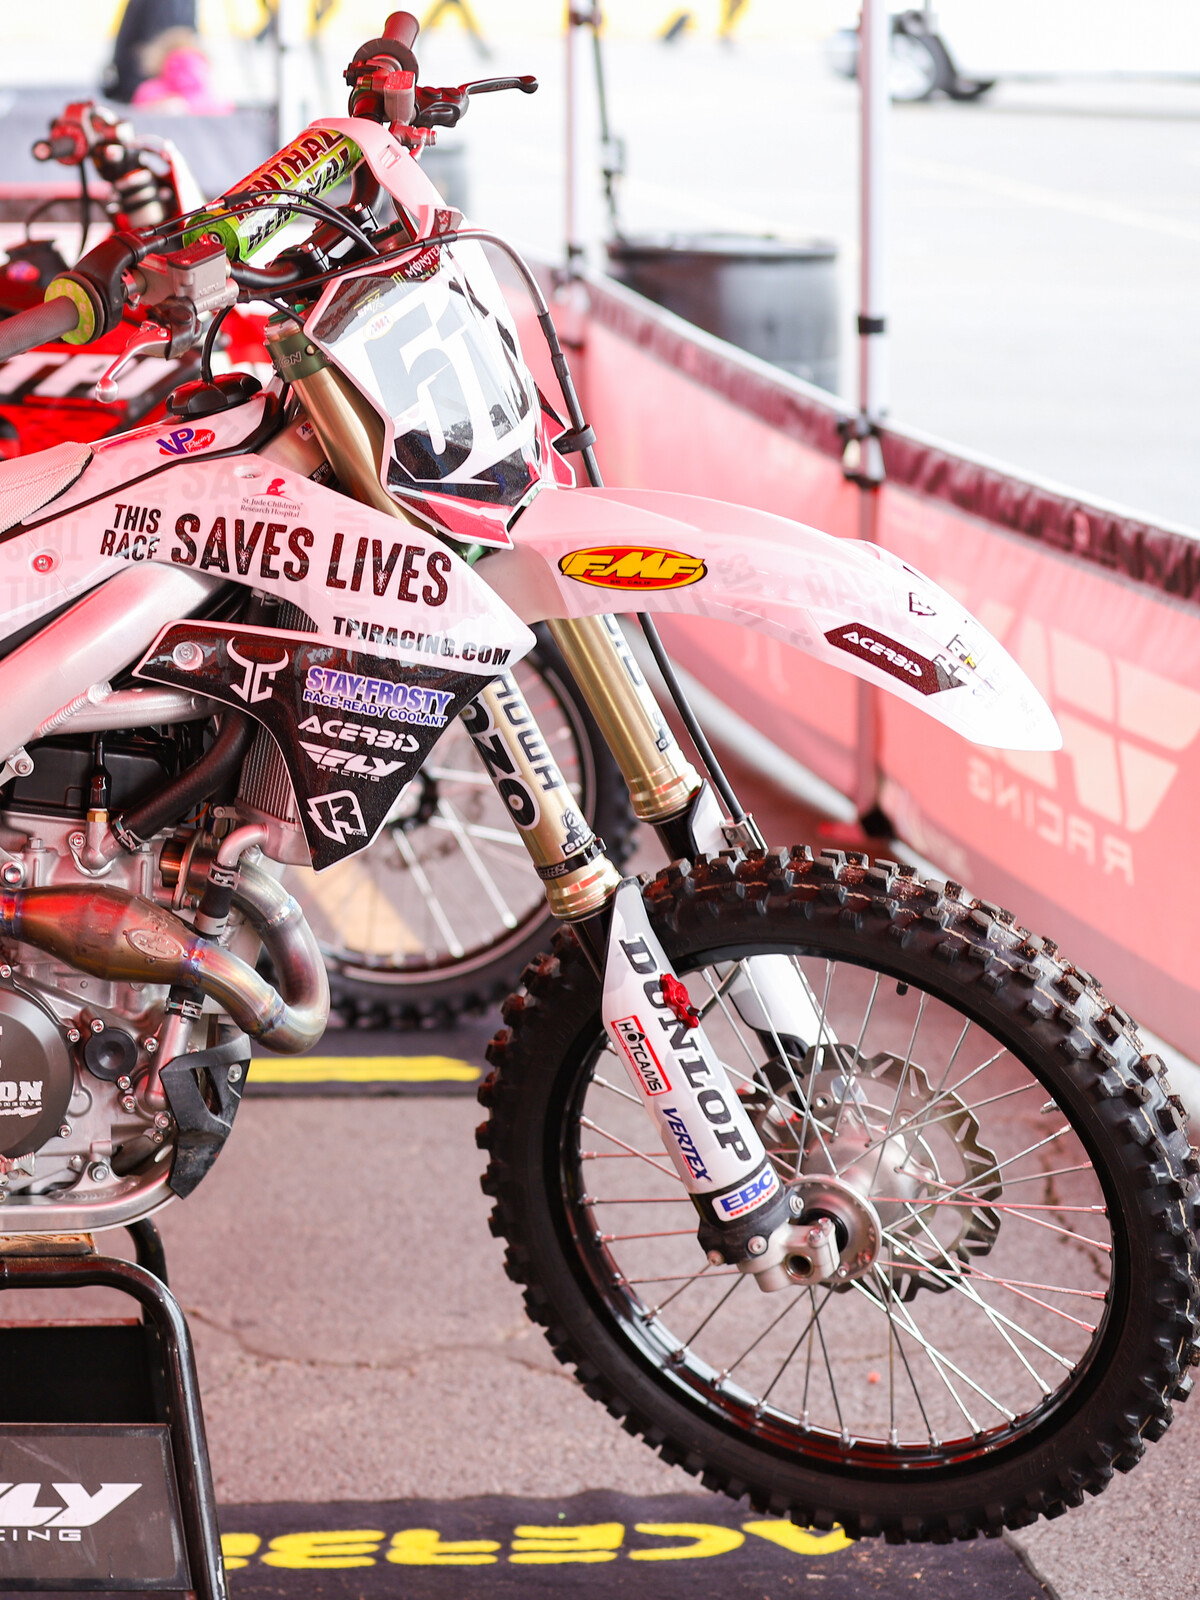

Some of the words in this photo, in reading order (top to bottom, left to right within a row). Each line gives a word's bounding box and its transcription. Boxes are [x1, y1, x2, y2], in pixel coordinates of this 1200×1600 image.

[227, 129, 345, 222] RENTHAL
[156, 428, 194, 455] VP
[114, 504, 162, 533] THIS
[241, 504, 270, 515] Research
[271, 508, 300, 519] Hospital
[252, 498, 267, 507] Jude
[100, 529, 161, 561] RACE
[171, 513, 315, 582] SAVES
[326, 533, 452, 607] LIVES
[562, 551, 706, 580] FMF
[303, 690, 386, 717] RACE-READY
[388, 708, 448, 728] COOLANT
[492, 671, 561, 791] HOWA
[299, 741, 406, 777] FLY
[317, 764, 380, 782] RACING
[618, 935, 752, 1162] DUNLOP
[662, 1107, 712, 1182] VERTEX
[720, 1170, 775, 1212] EBC
[729, 1184, 777, 1217] BRAKES
